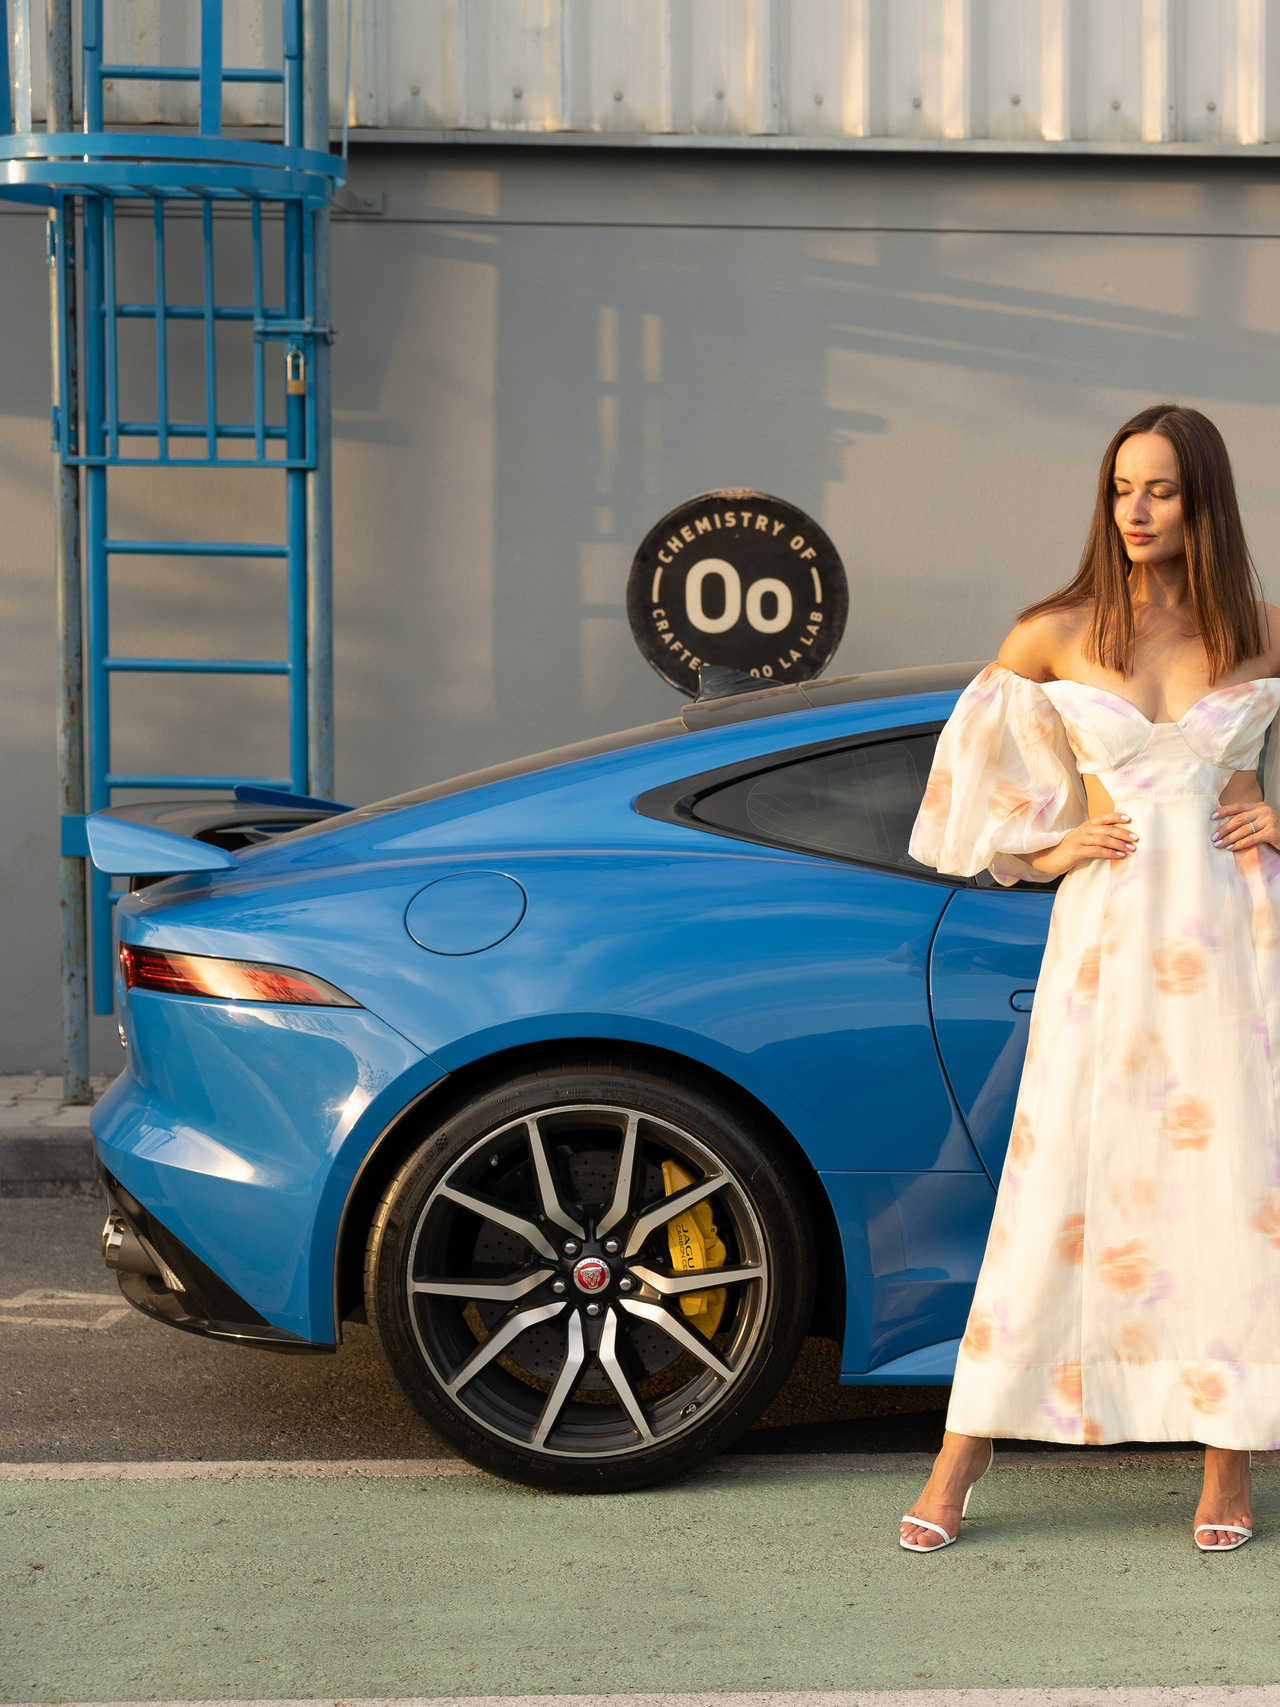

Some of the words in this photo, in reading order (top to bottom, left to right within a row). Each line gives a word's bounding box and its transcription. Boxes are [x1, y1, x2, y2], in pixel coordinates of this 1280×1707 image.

[657, 511, 786, 565] CHEMISTRY
[790, 535, 817, 562] OF
[652, 608, 712, 672] CRAFTE
[778, 650, 802, 670] LA
[799, 610, 824, 646] LAB
